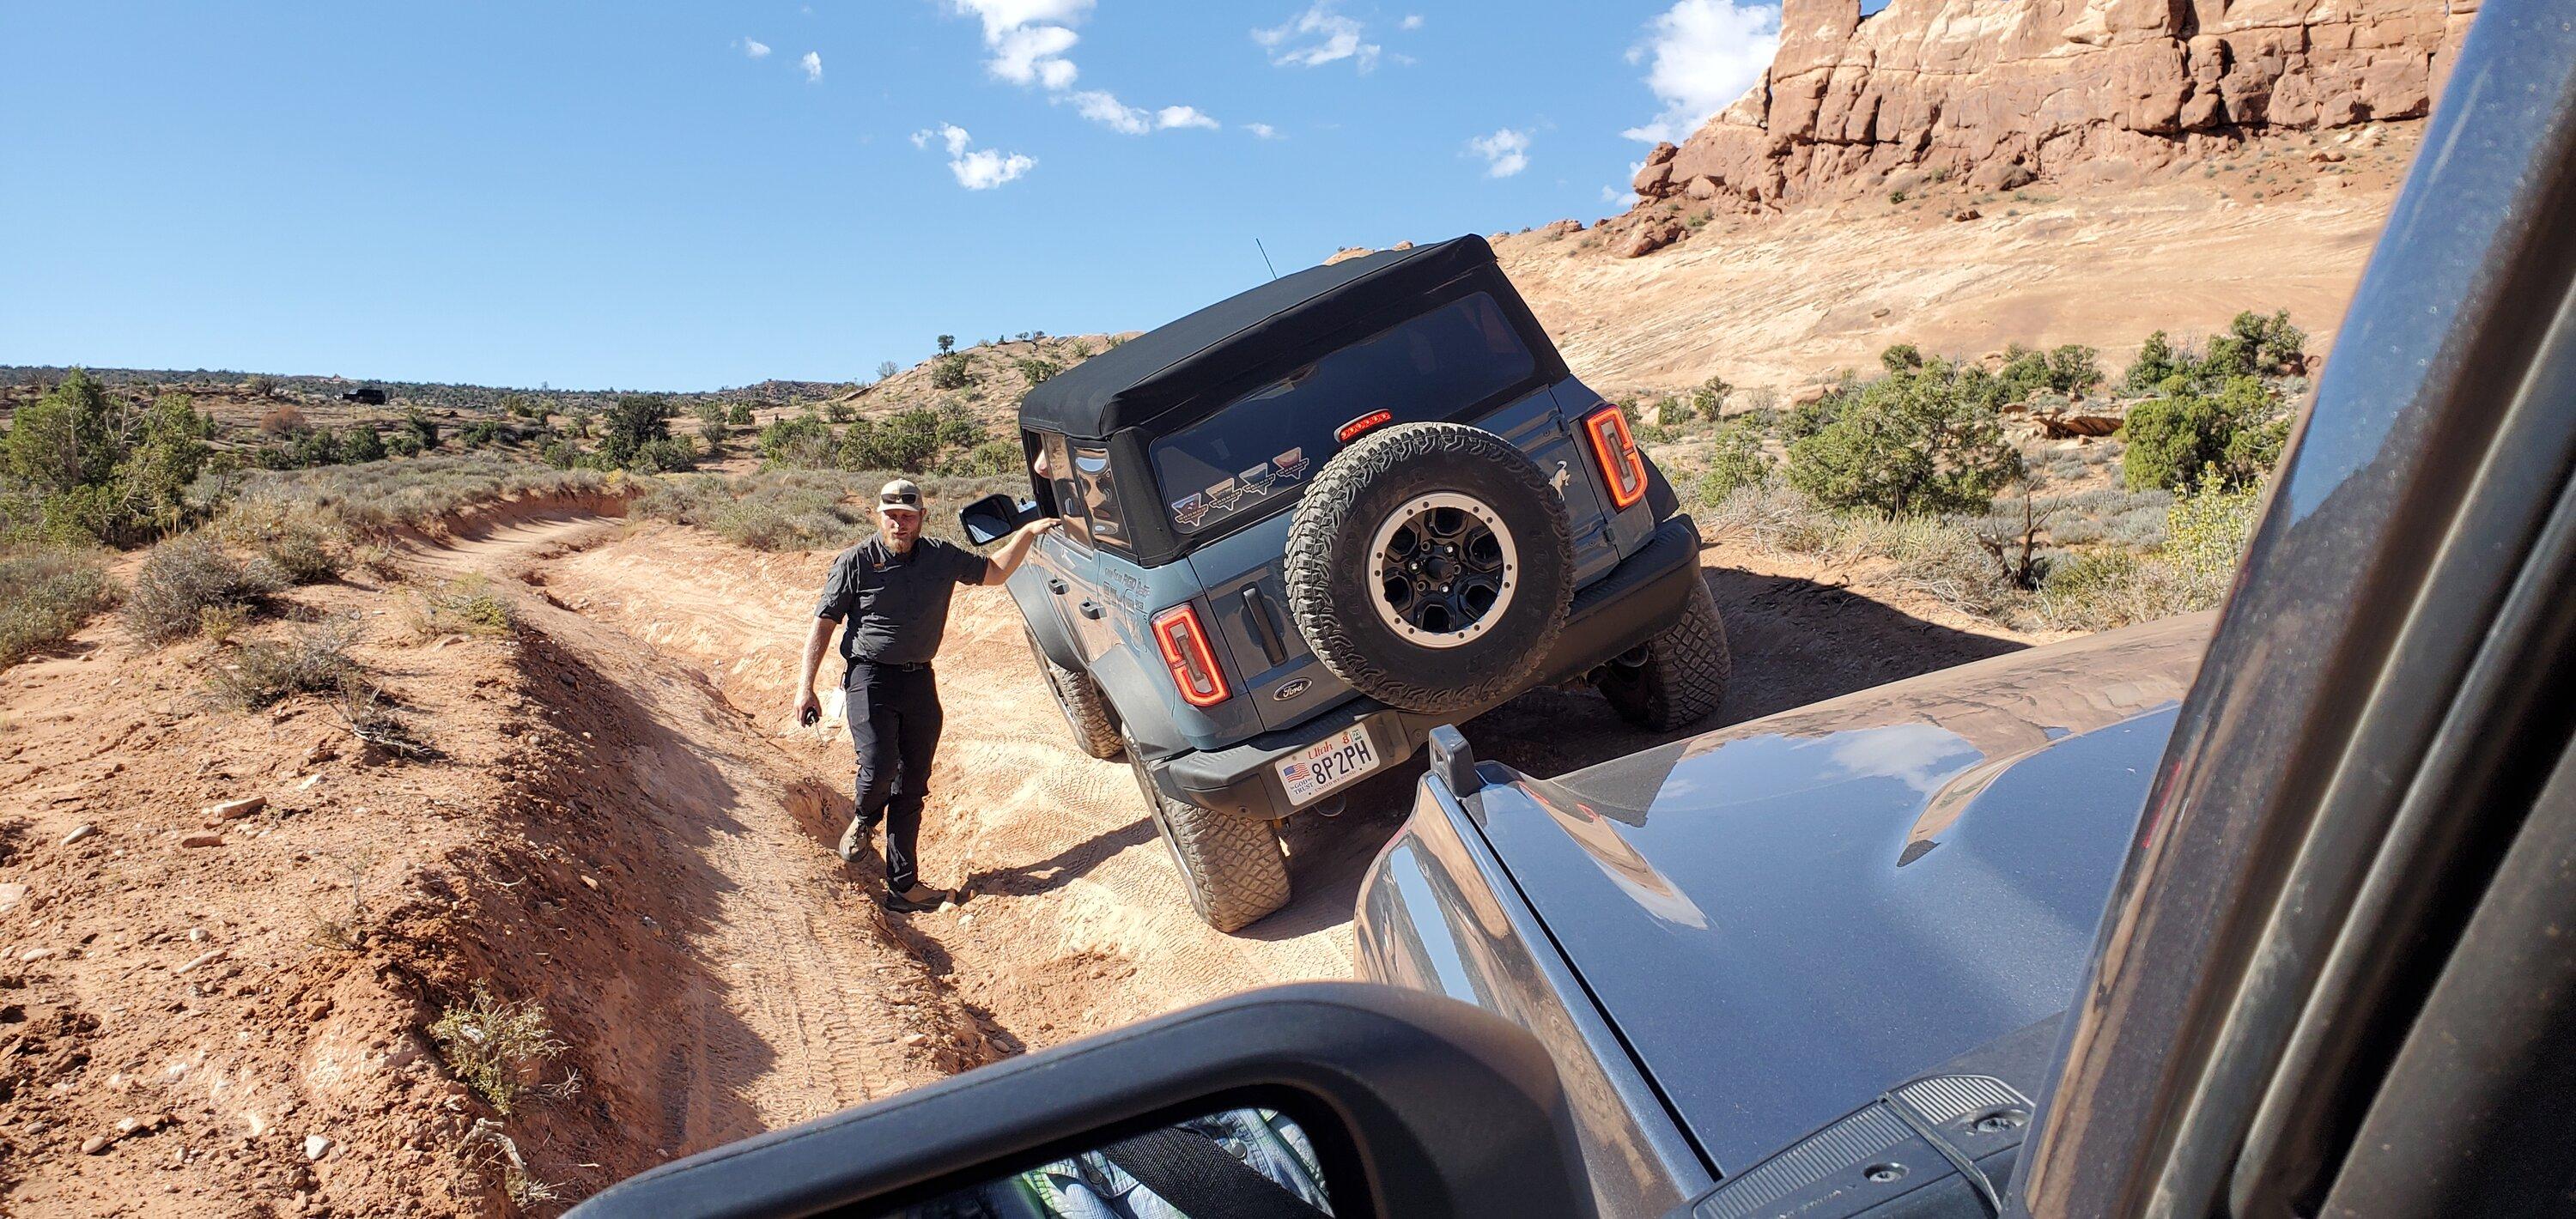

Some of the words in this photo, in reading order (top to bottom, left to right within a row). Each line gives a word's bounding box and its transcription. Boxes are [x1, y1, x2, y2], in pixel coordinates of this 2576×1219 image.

[1283, 682, 1304, 698] Ford
[1308, 741, 1334, 761] Utah
[1342, 736, 1350, 744] 8
[1311, 739, 1372, 785] 8P2PH
[1294, 779, 1309, 789] GOD
[1294, 782, 1314, 795] TRUST
[1315, 781, 1333, 792] UNITED
